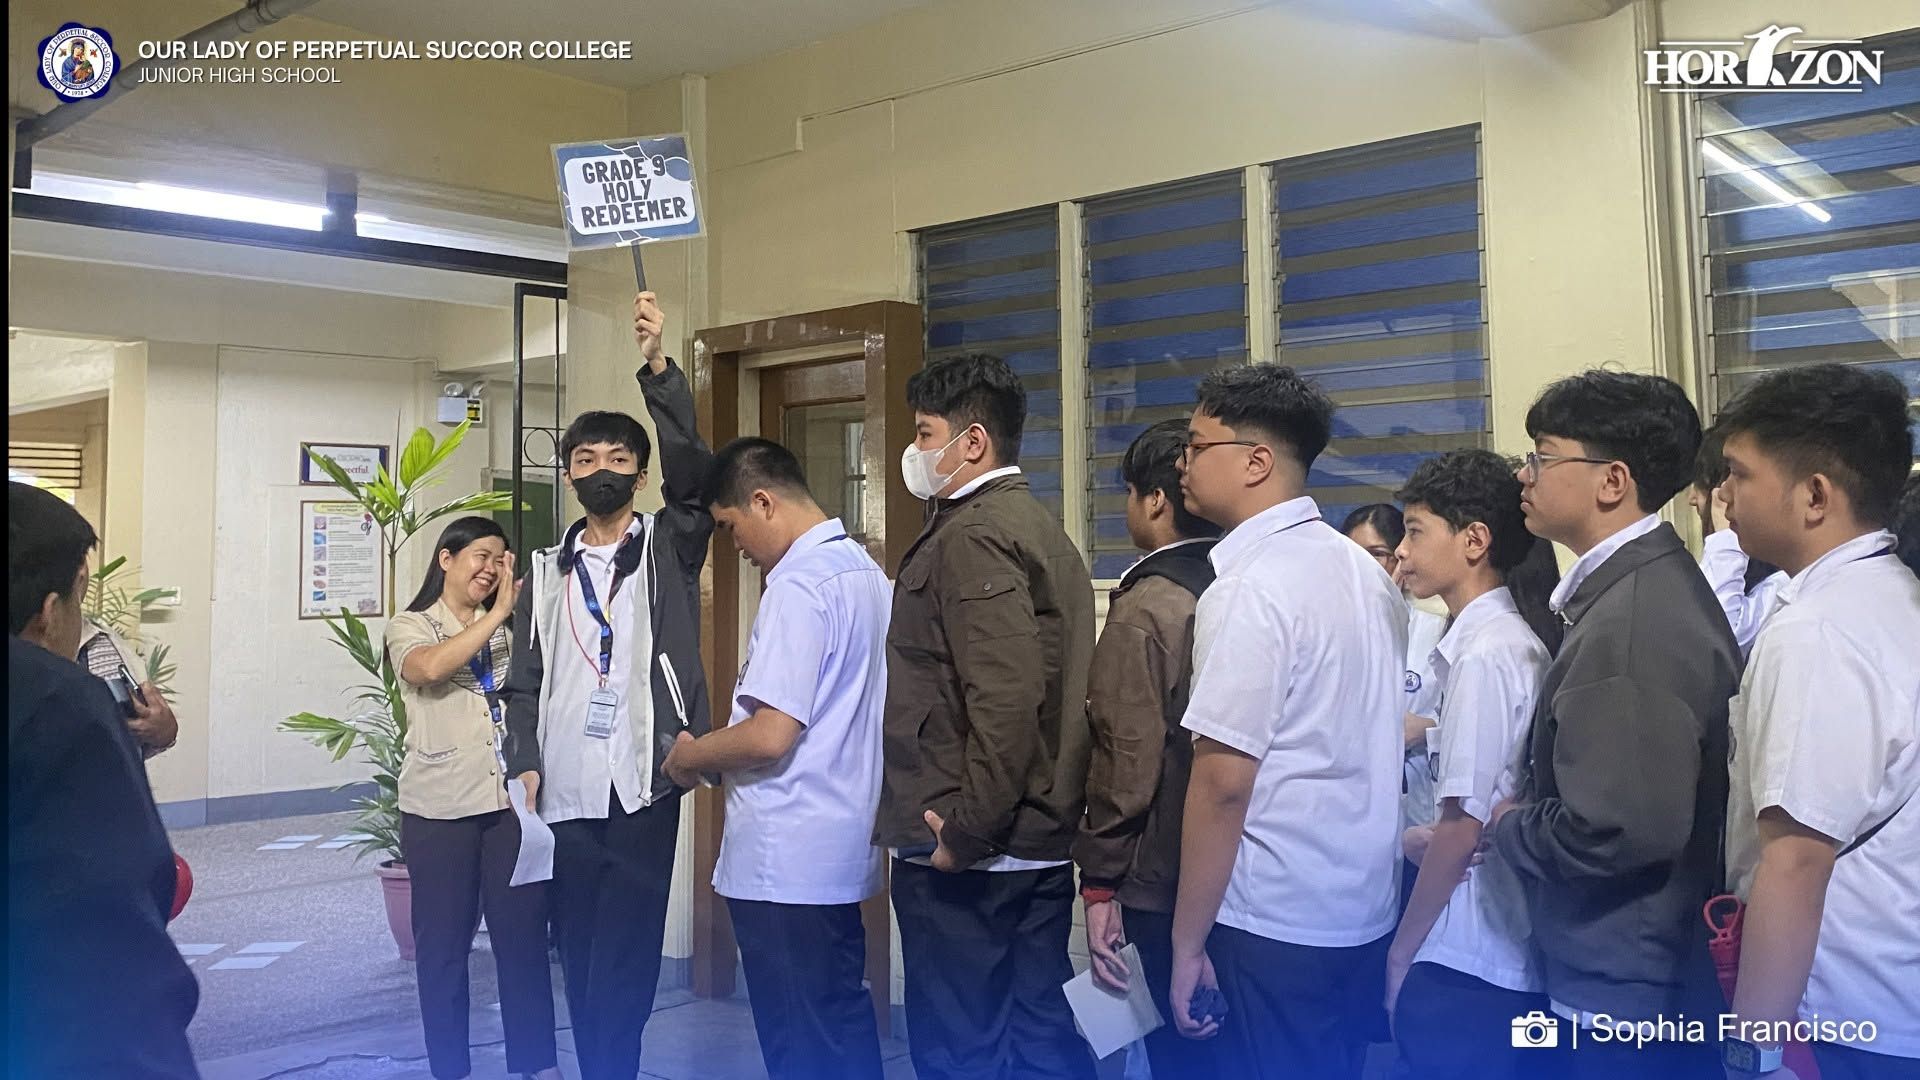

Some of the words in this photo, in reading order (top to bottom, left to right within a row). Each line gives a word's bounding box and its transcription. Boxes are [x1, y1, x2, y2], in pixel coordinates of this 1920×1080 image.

[582, 157, 648, 184] GRADE
[652, 155, 666, 176] 9
[602, 178, 652, 204] HOLY
[581, 196, 688, 229] REDEEMER
